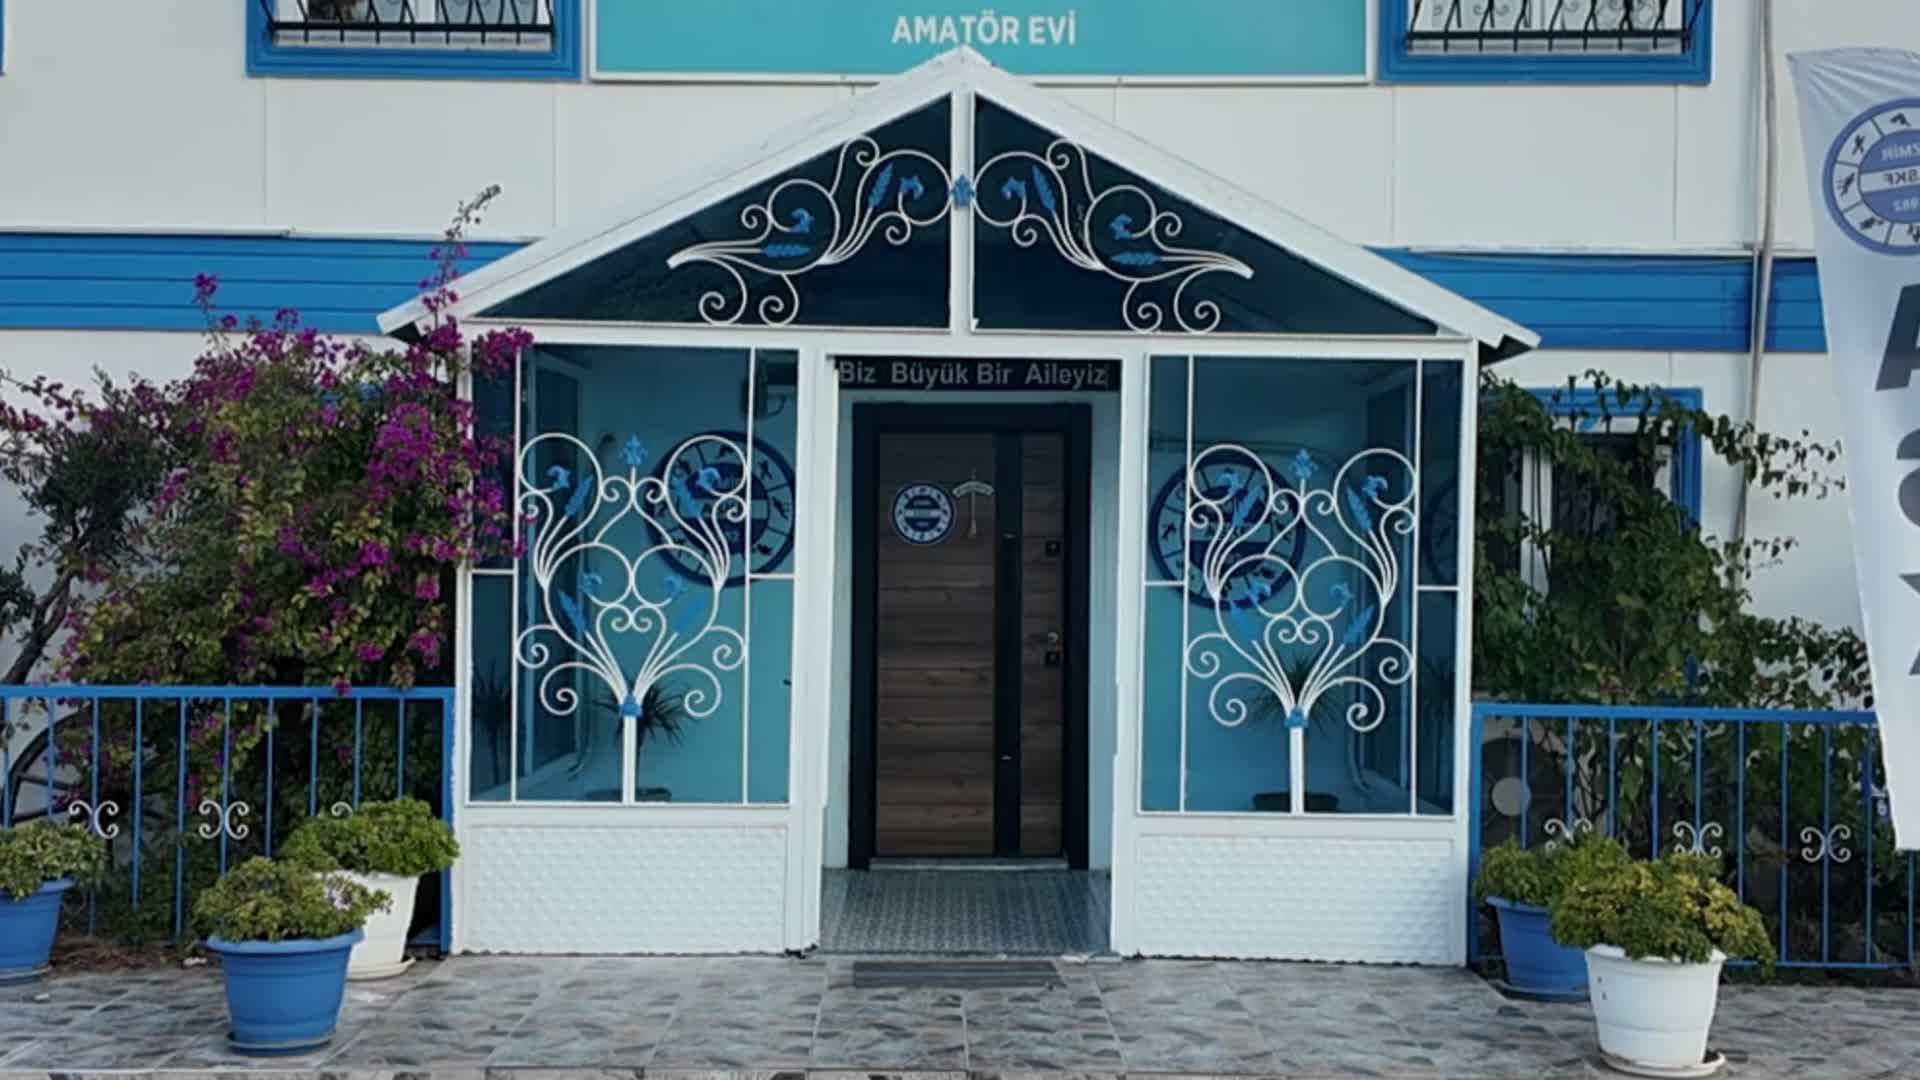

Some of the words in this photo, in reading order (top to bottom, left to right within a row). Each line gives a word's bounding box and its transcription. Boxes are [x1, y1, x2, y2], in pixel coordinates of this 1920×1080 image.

[892, 9, 1020, 44] AMATÖR
[1028, 9, 1077, 45] EVİ
[838, 360, 877, 384] Biz
[891, 360, 969, 390] Büyük
[977, 362, 1013, 385] Bir
[1024, 362, 1108, 390] Aileyiz
